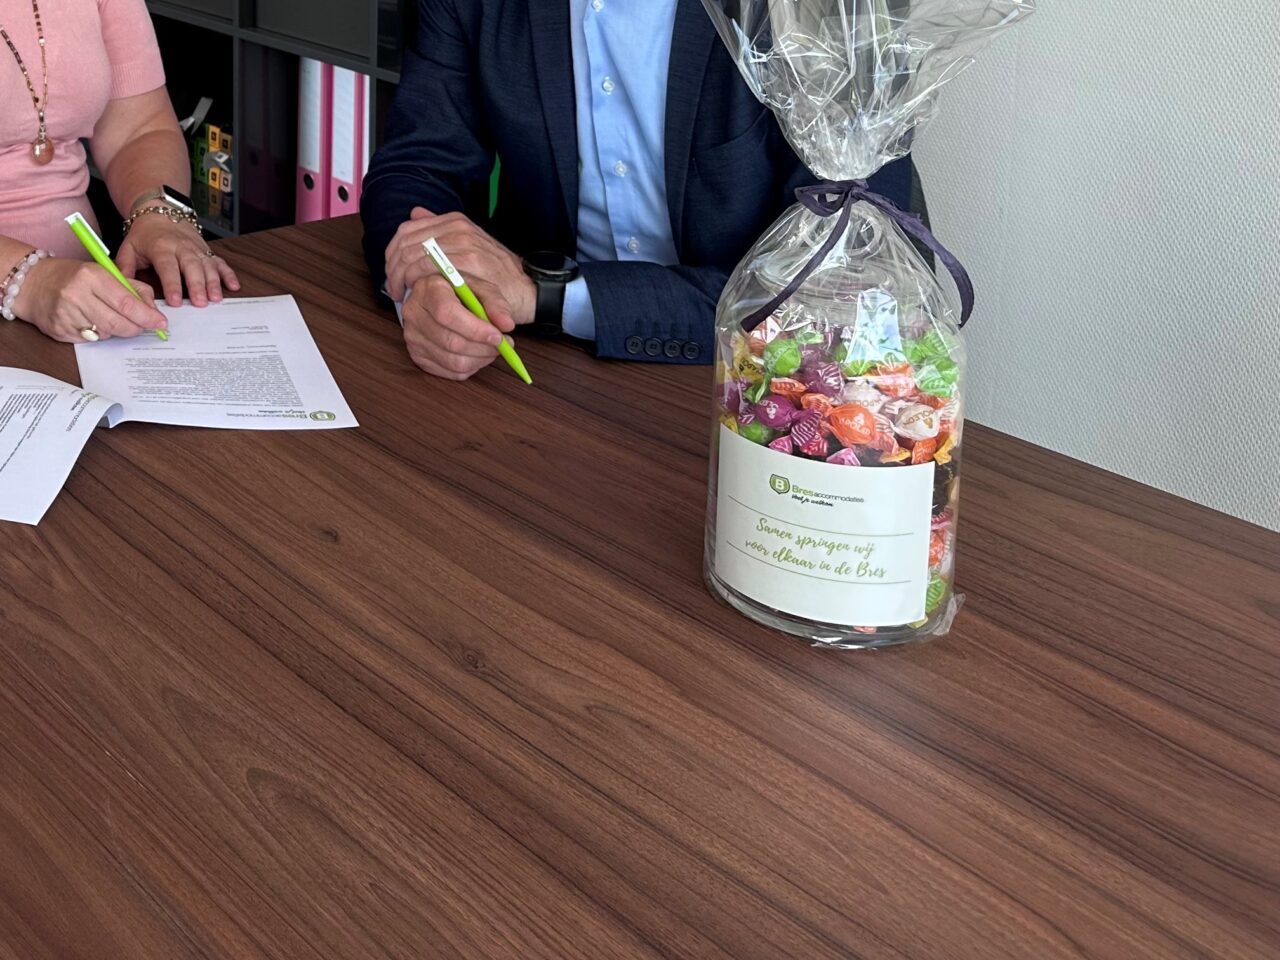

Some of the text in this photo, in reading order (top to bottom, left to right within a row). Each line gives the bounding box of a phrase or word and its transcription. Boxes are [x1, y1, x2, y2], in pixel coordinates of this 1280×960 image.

[756, 517, 875, 559] Samen springen wij
[745, 539, 887, 578] voor elkaar in de Bres
